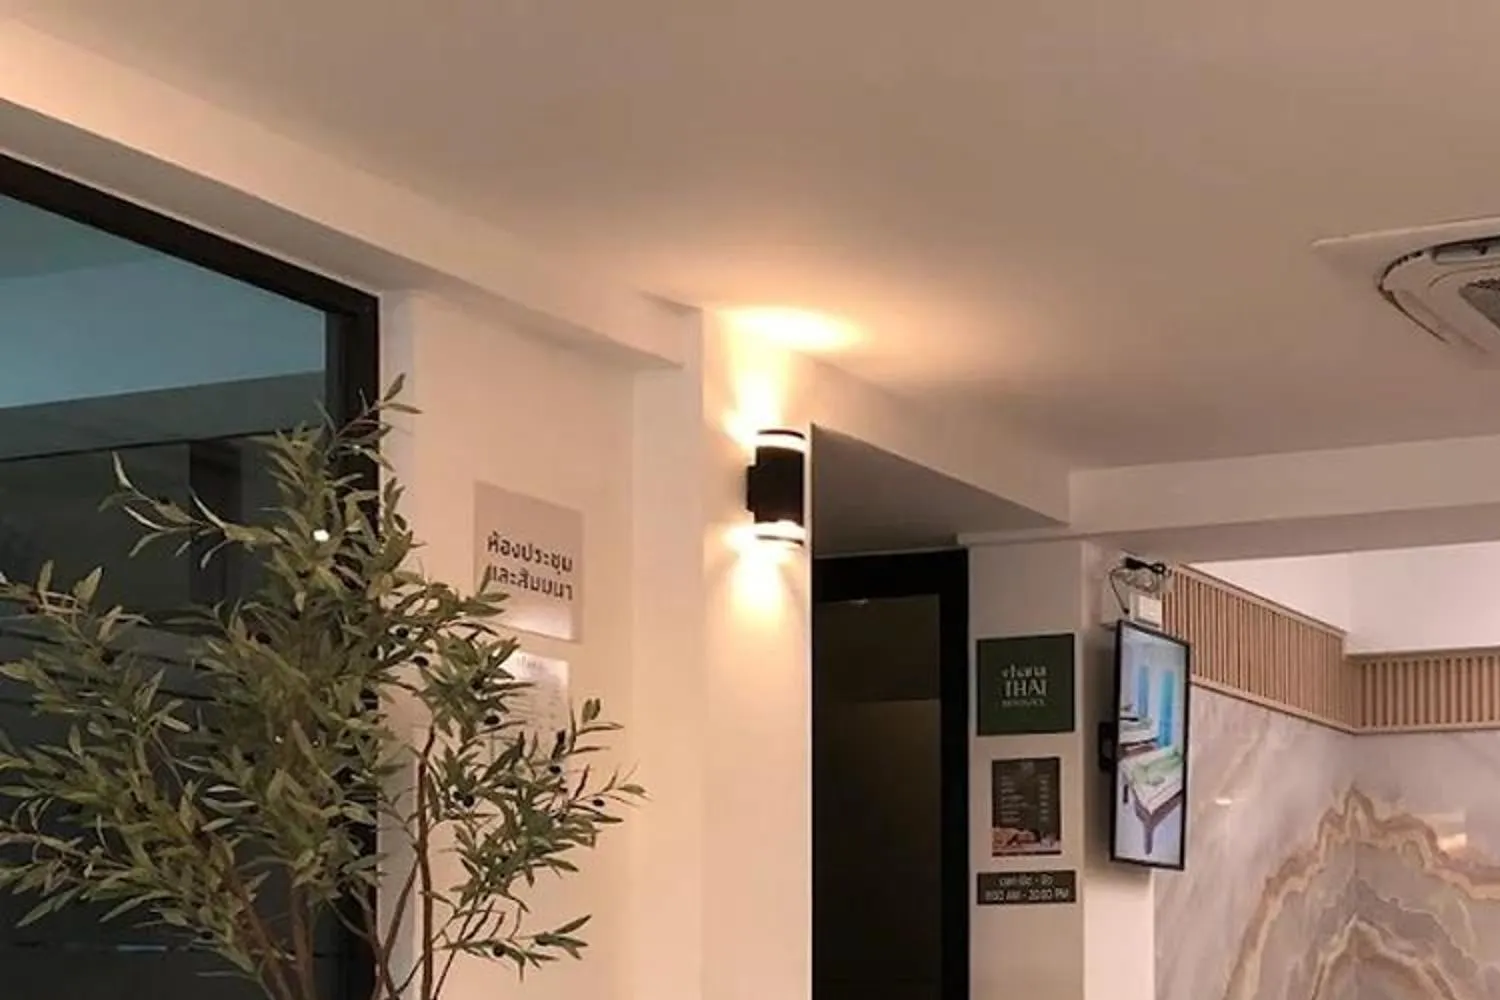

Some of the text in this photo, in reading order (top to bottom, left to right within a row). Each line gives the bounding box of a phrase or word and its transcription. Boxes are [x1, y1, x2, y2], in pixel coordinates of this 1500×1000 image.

[487, 530, 574, 575] ห้องประชุม
[1003, 678, 1047, 697] THAI
